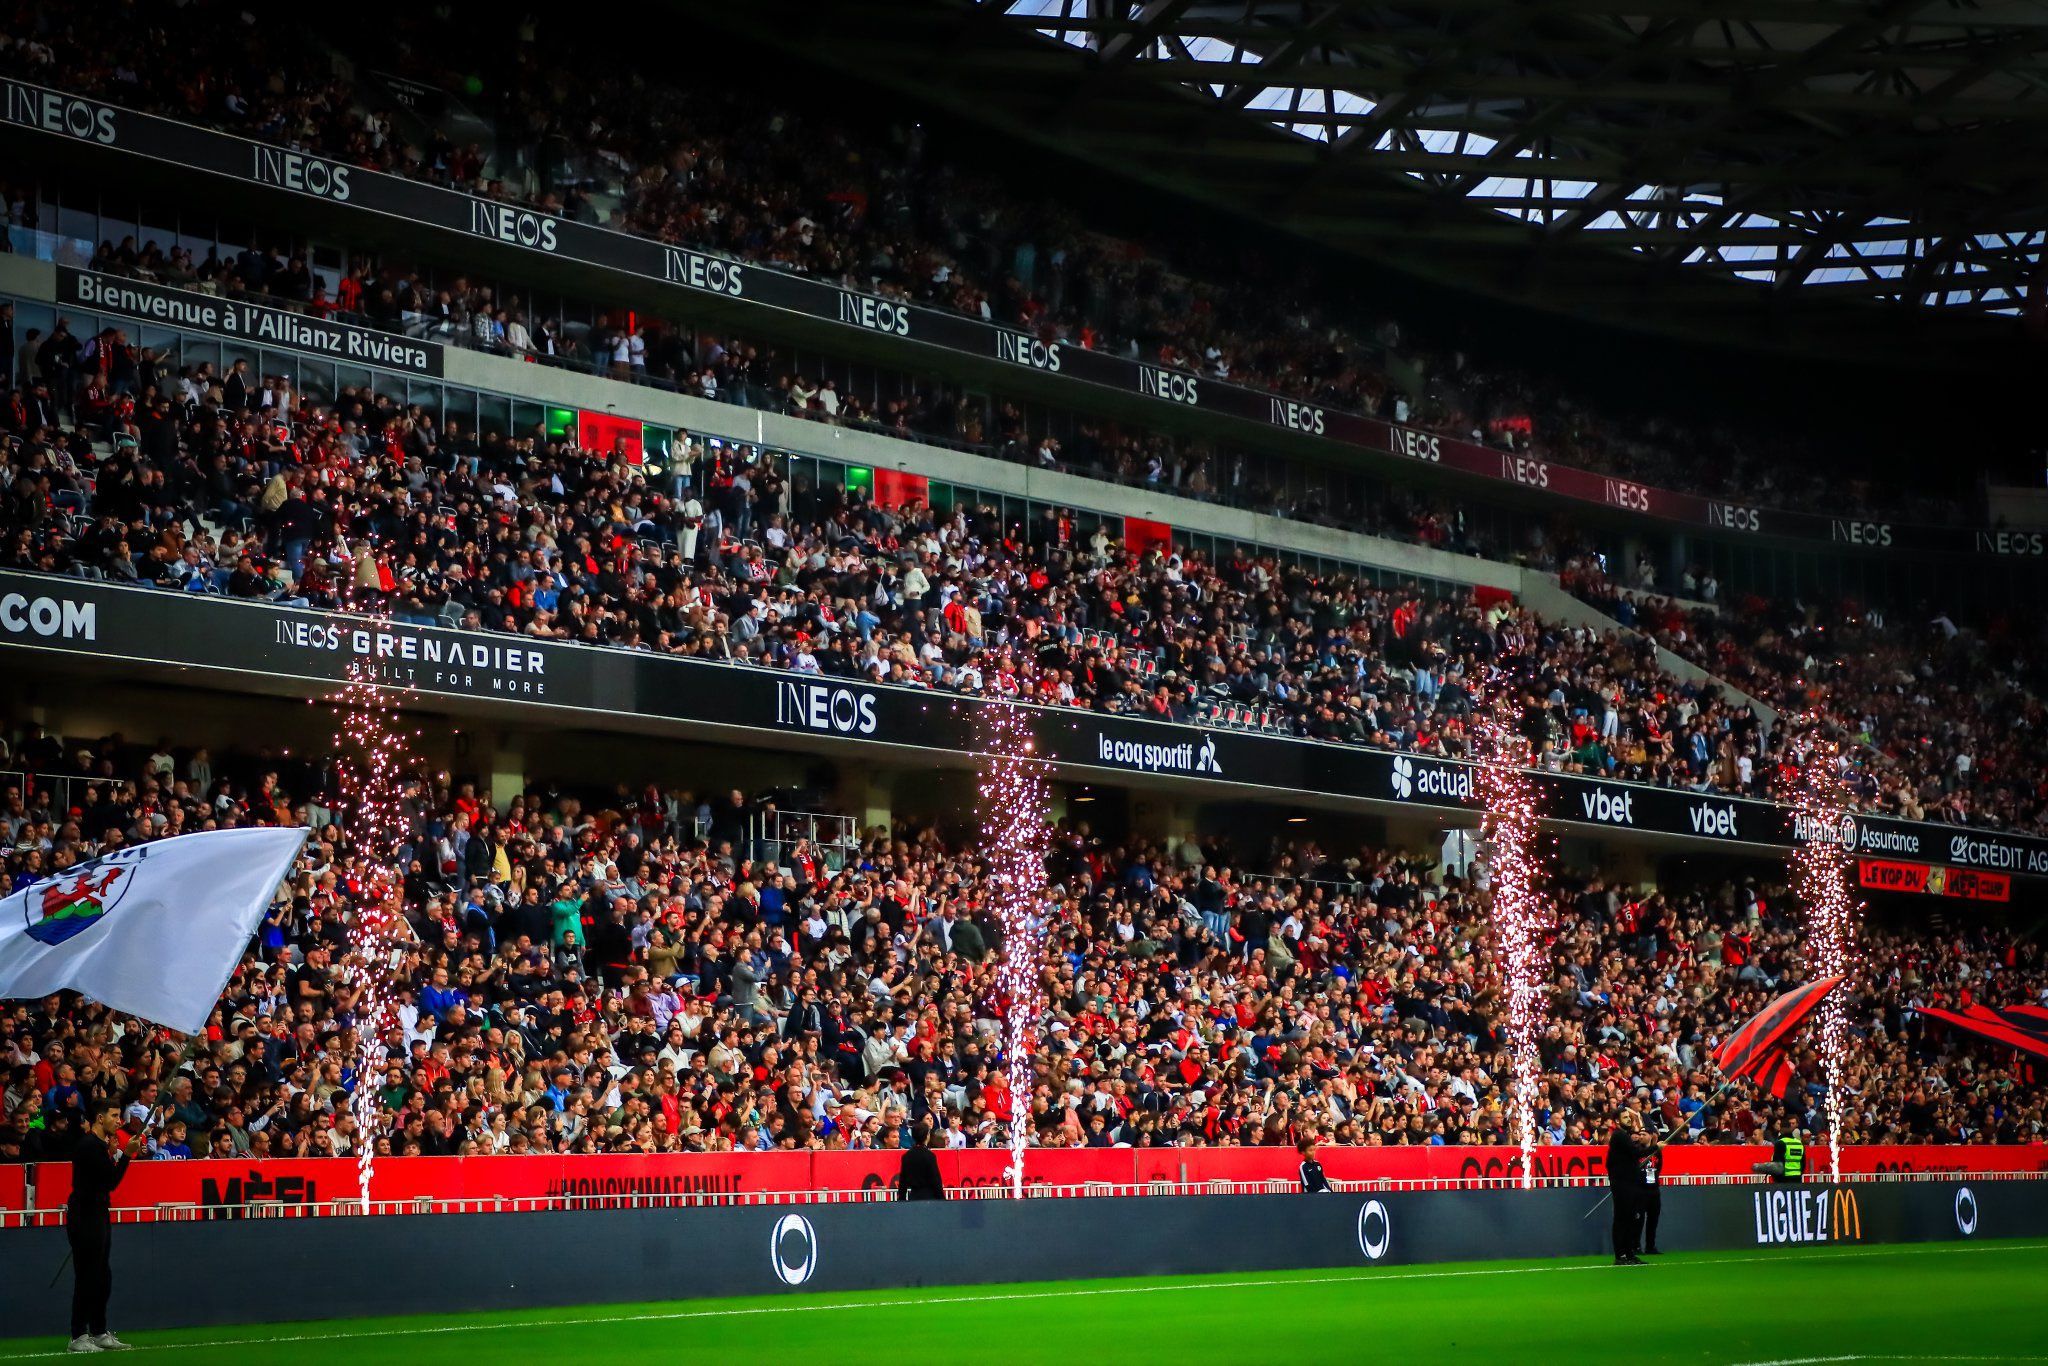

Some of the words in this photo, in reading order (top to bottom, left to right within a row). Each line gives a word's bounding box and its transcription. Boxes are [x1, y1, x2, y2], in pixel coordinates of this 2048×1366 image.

[7, 84, 116, 145] INEOS
[253, 146, 350, 200] INEOS
[471, 201, 557, 251] INEOS
[665, 247, 742, 296] INEOS
[78, 274, 216, 327] Bienvenue
[223, 303, 237, 331] à
[244, 307, 341, 352] l'Allianz
[348, 330, 427, 369] Riviera
[839, 291, 909, 336] INEOS
[997, 330, 1060, 372] INEOS
[1139, 366, 1198, 405] INEOS
[1271, 398, 1324, 435] INEOS
[1390, 427, 1441, 462] INEOS
[1502, 454, 1549, 488] INEOS
[1605, 479, 1649, 511] INEOS
[1708, 503, 1760, 532] INEOS
[1832, 519, 1892, 546] INEOS
[1976, 530, 2045, 555] INEOS
[1, 592, 96, 641] COM
[275, 619, 339, 650] INEOS
[352, 630, 545, 674] GRENADIER
[352, 661, 416, 680] BUILT
[436, 672, 473, 687] FOR
[493, 678, 545, 695] MORE
[776, 681, 877, 734] INEOS
[1099, 732, 1115, 760] le
[1115, 742, 1143, 770] coq
[1144, 742, 1193, 770] sportif
[1417, 766, 1475, 797] actual
[1582, 787, 1633, 824] vbet
[1688, 801, 1738, 837] vbet
[1861, 824, 1919, 853] Assurance
[1968, 839, 2024, 869] CRÉDIT
[1905, 870, 1921, 887] DU
[1754, 1190, 1814, 1243] LIGUE
